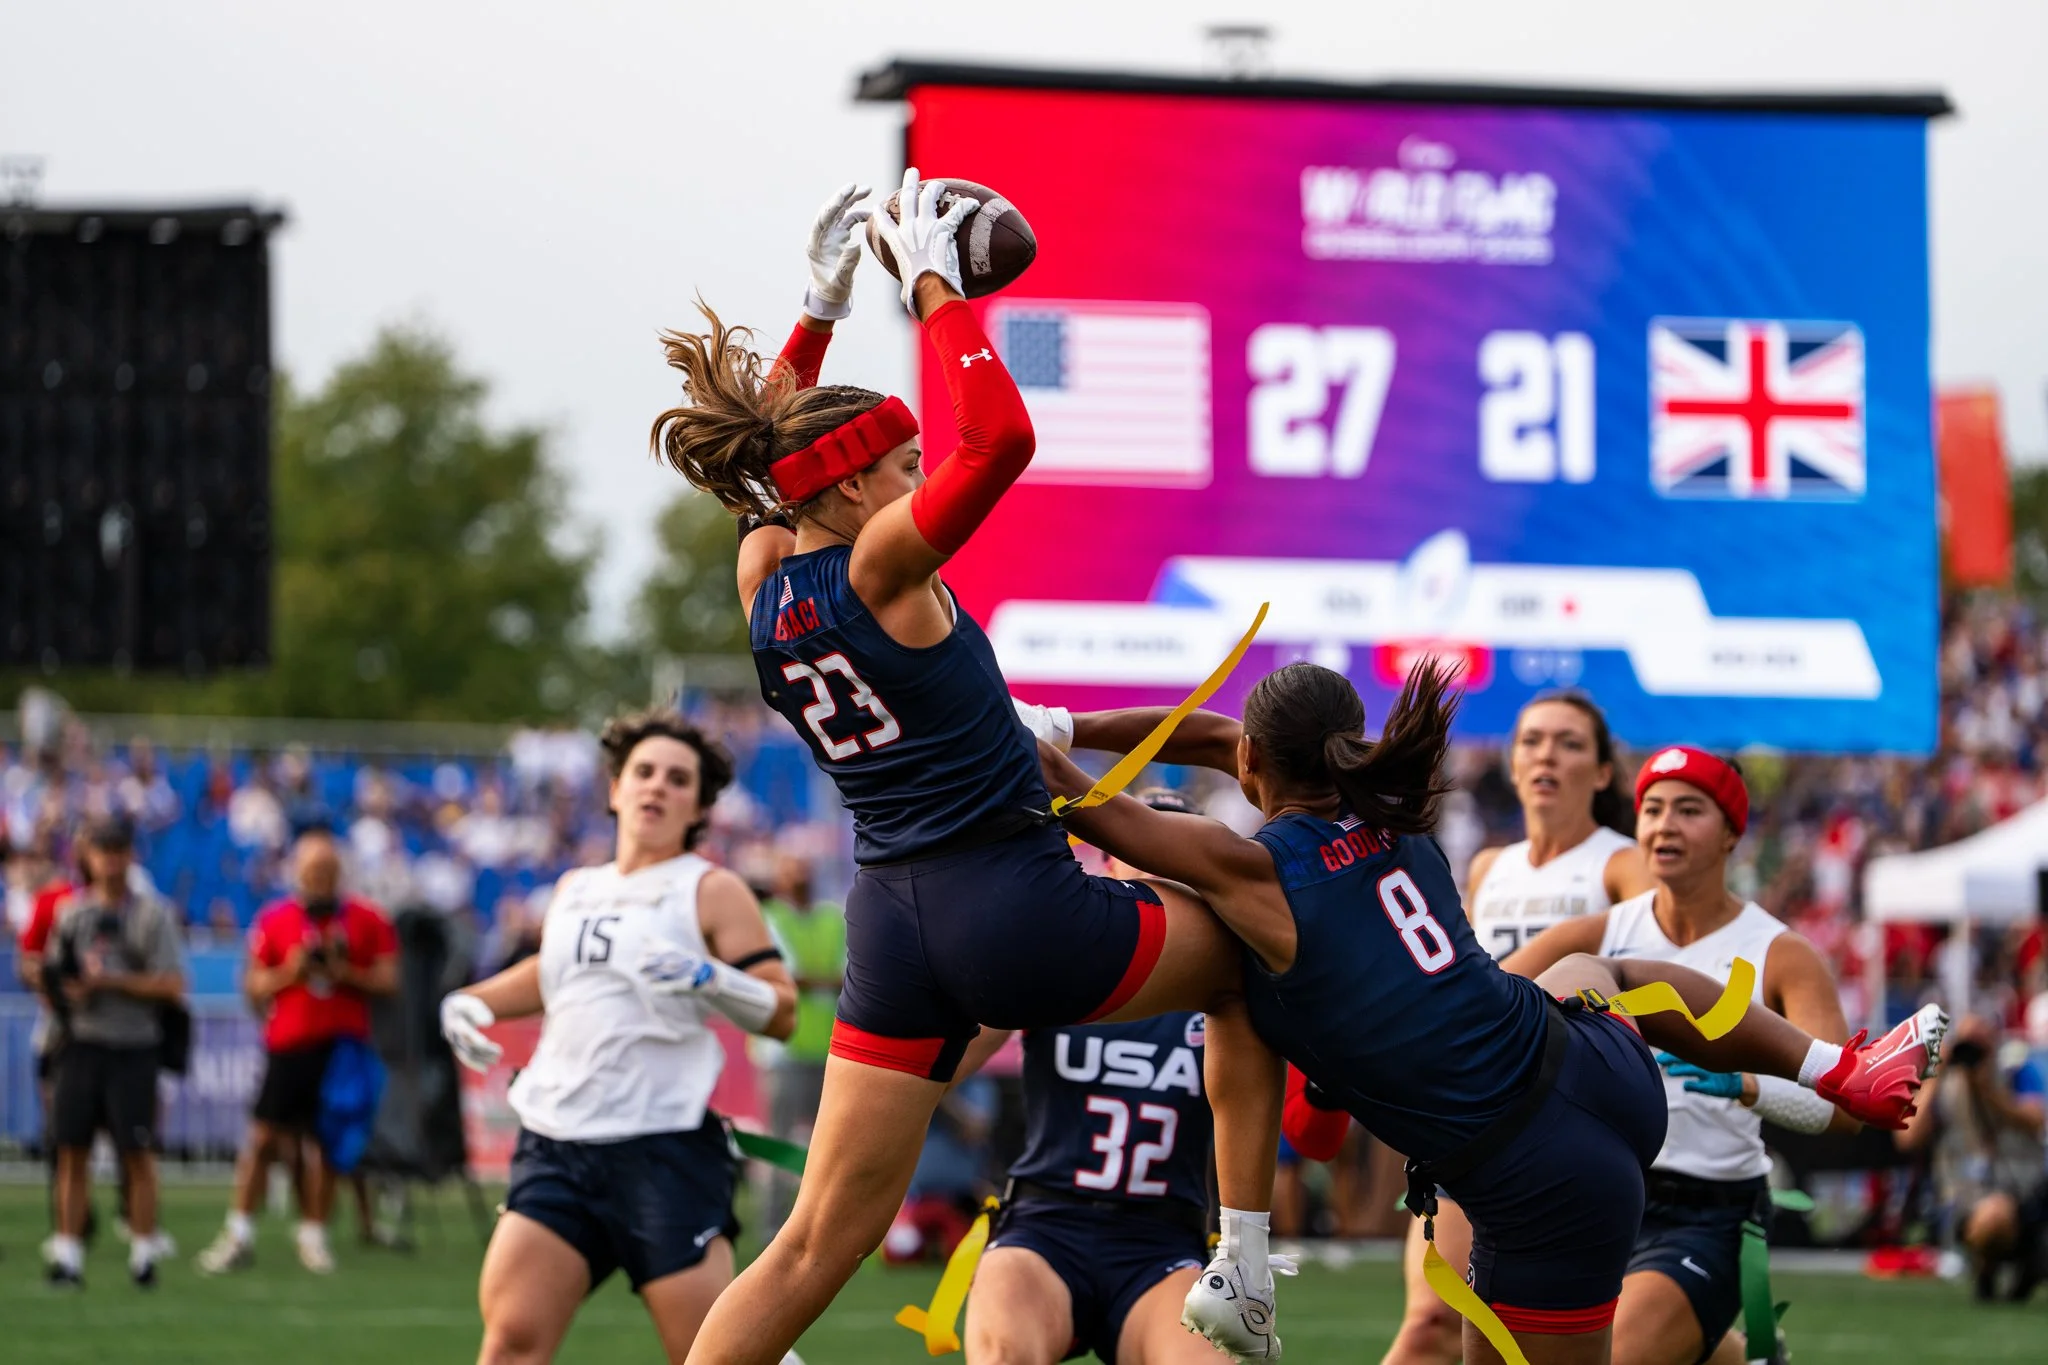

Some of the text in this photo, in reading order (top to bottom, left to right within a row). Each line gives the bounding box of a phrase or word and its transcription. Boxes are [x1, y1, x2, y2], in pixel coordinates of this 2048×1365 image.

[1246, 322, 1397, 478] 27
[1478, 329, 1596, 484] 21
[781, 652, 902, 761] 23
[576, 916, 622, 964] 15
[1377, 868, 1456, 974] 8
[1055, 1033, 1201, 1097] USA
[1075, 1095, 1179, 1196] 32
